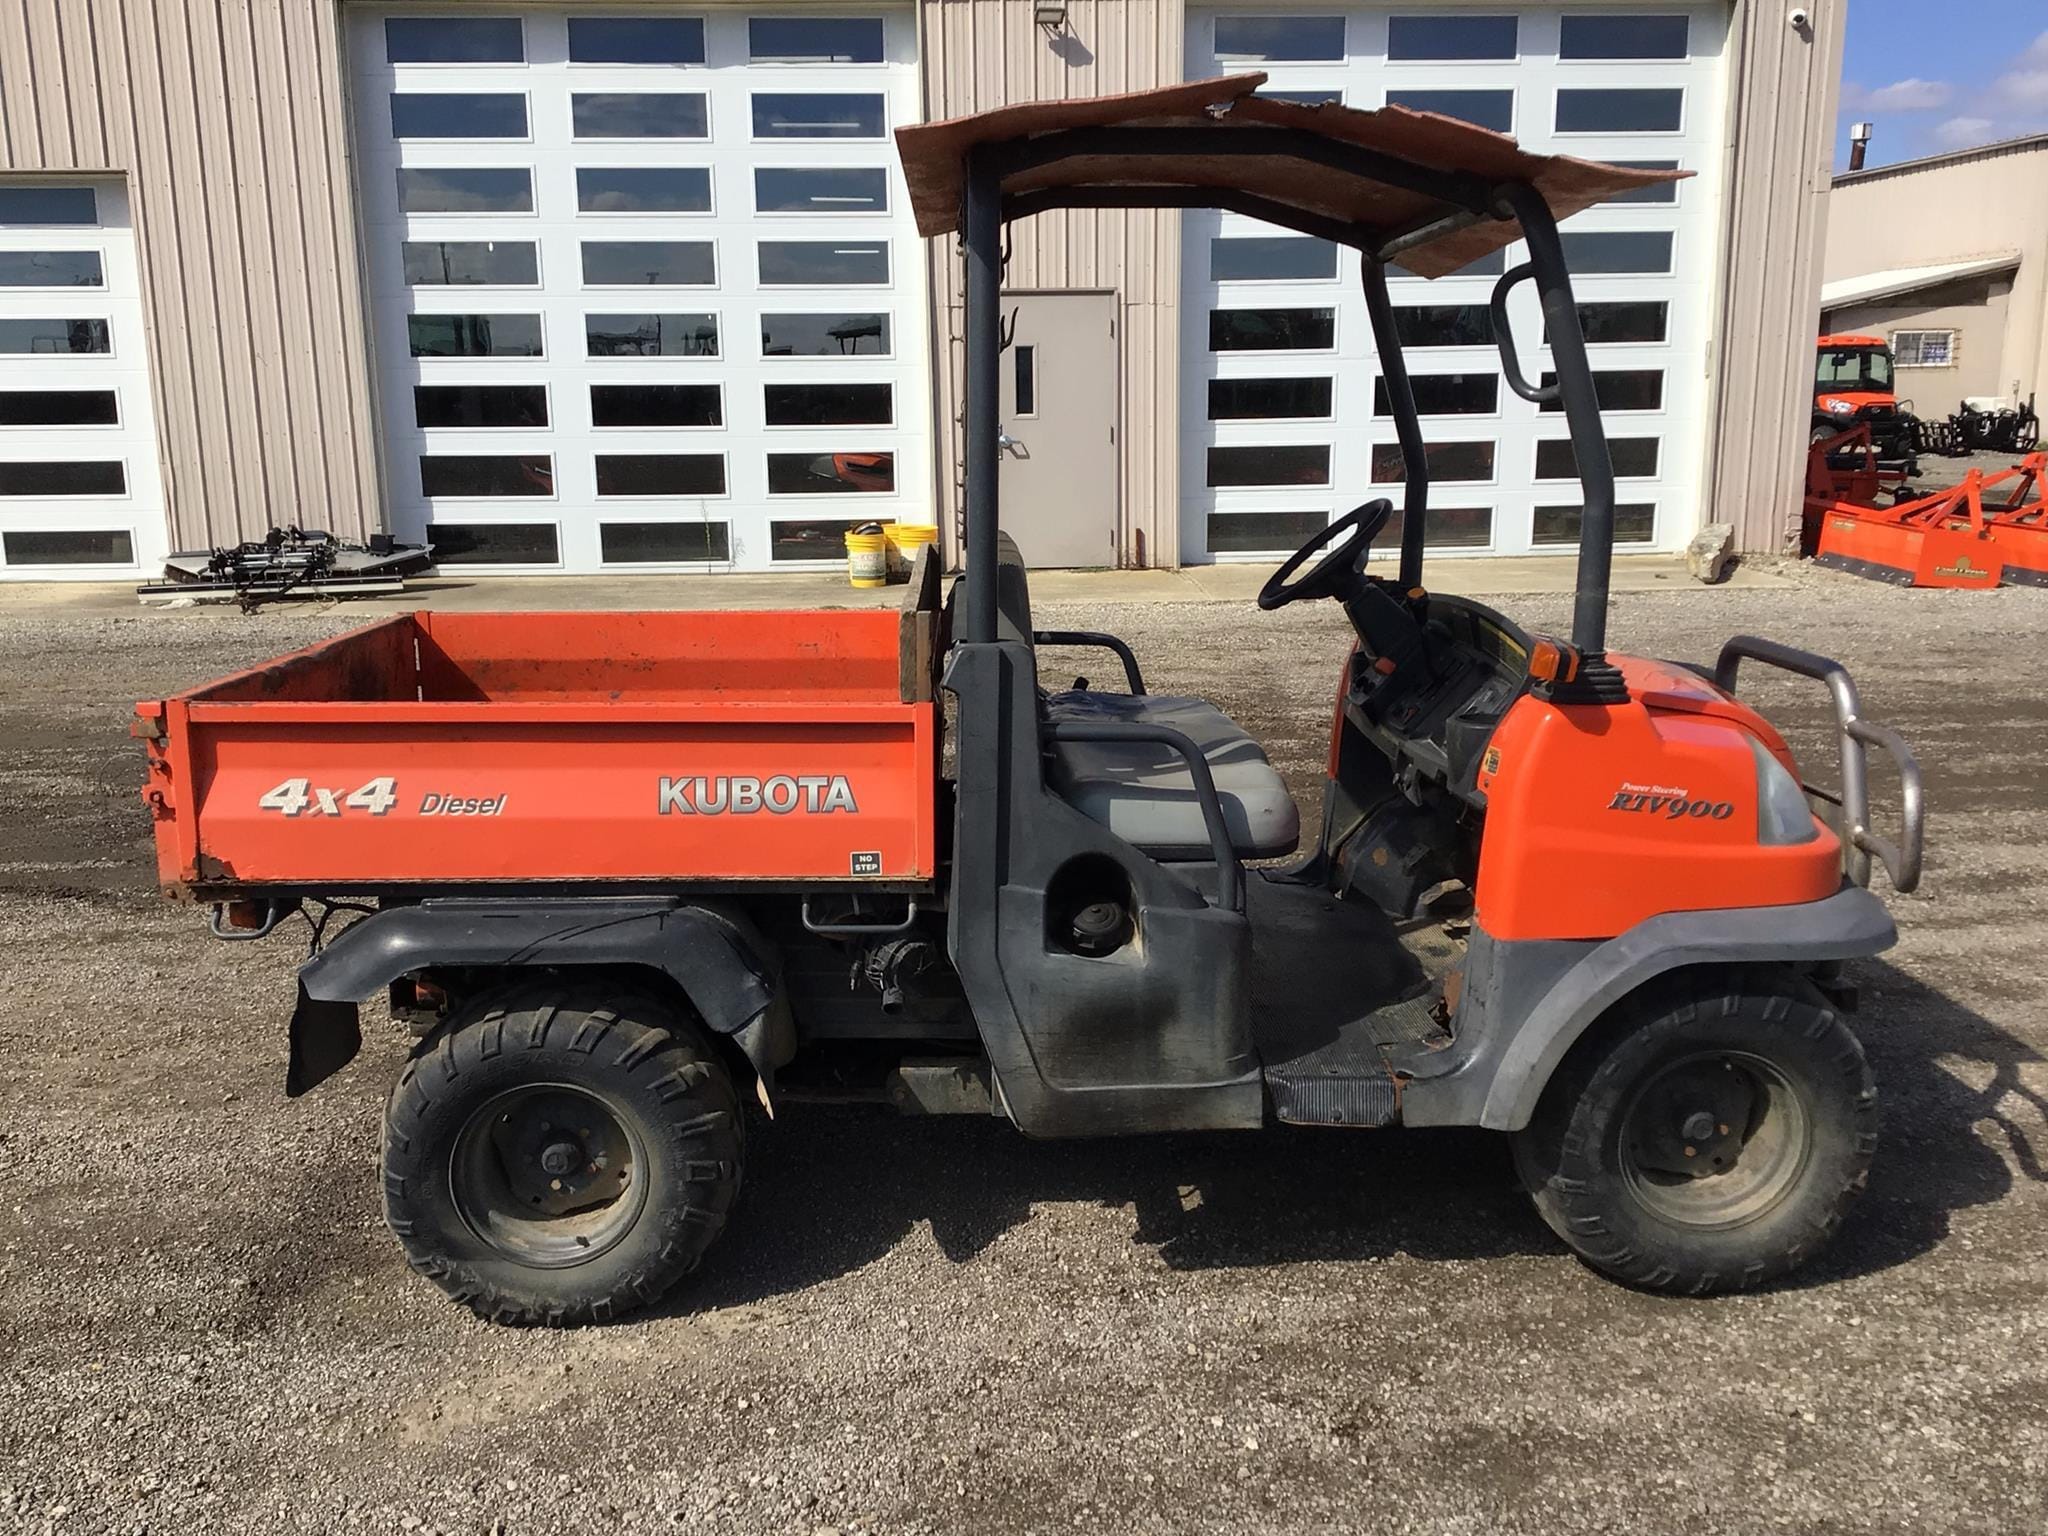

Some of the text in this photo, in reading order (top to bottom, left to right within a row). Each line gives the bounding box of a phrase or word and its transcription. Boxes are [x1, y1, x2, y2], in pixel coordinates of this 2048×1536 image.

[258, 777, 508, 817] 4x4 Diesel
[658, 775, 859, 815] KUBOTA
[1621, 782, 1688, 797] Power Steering
[1606, 792, 1734, 820] RTV900
[855, 863, 878, 871] STEP
